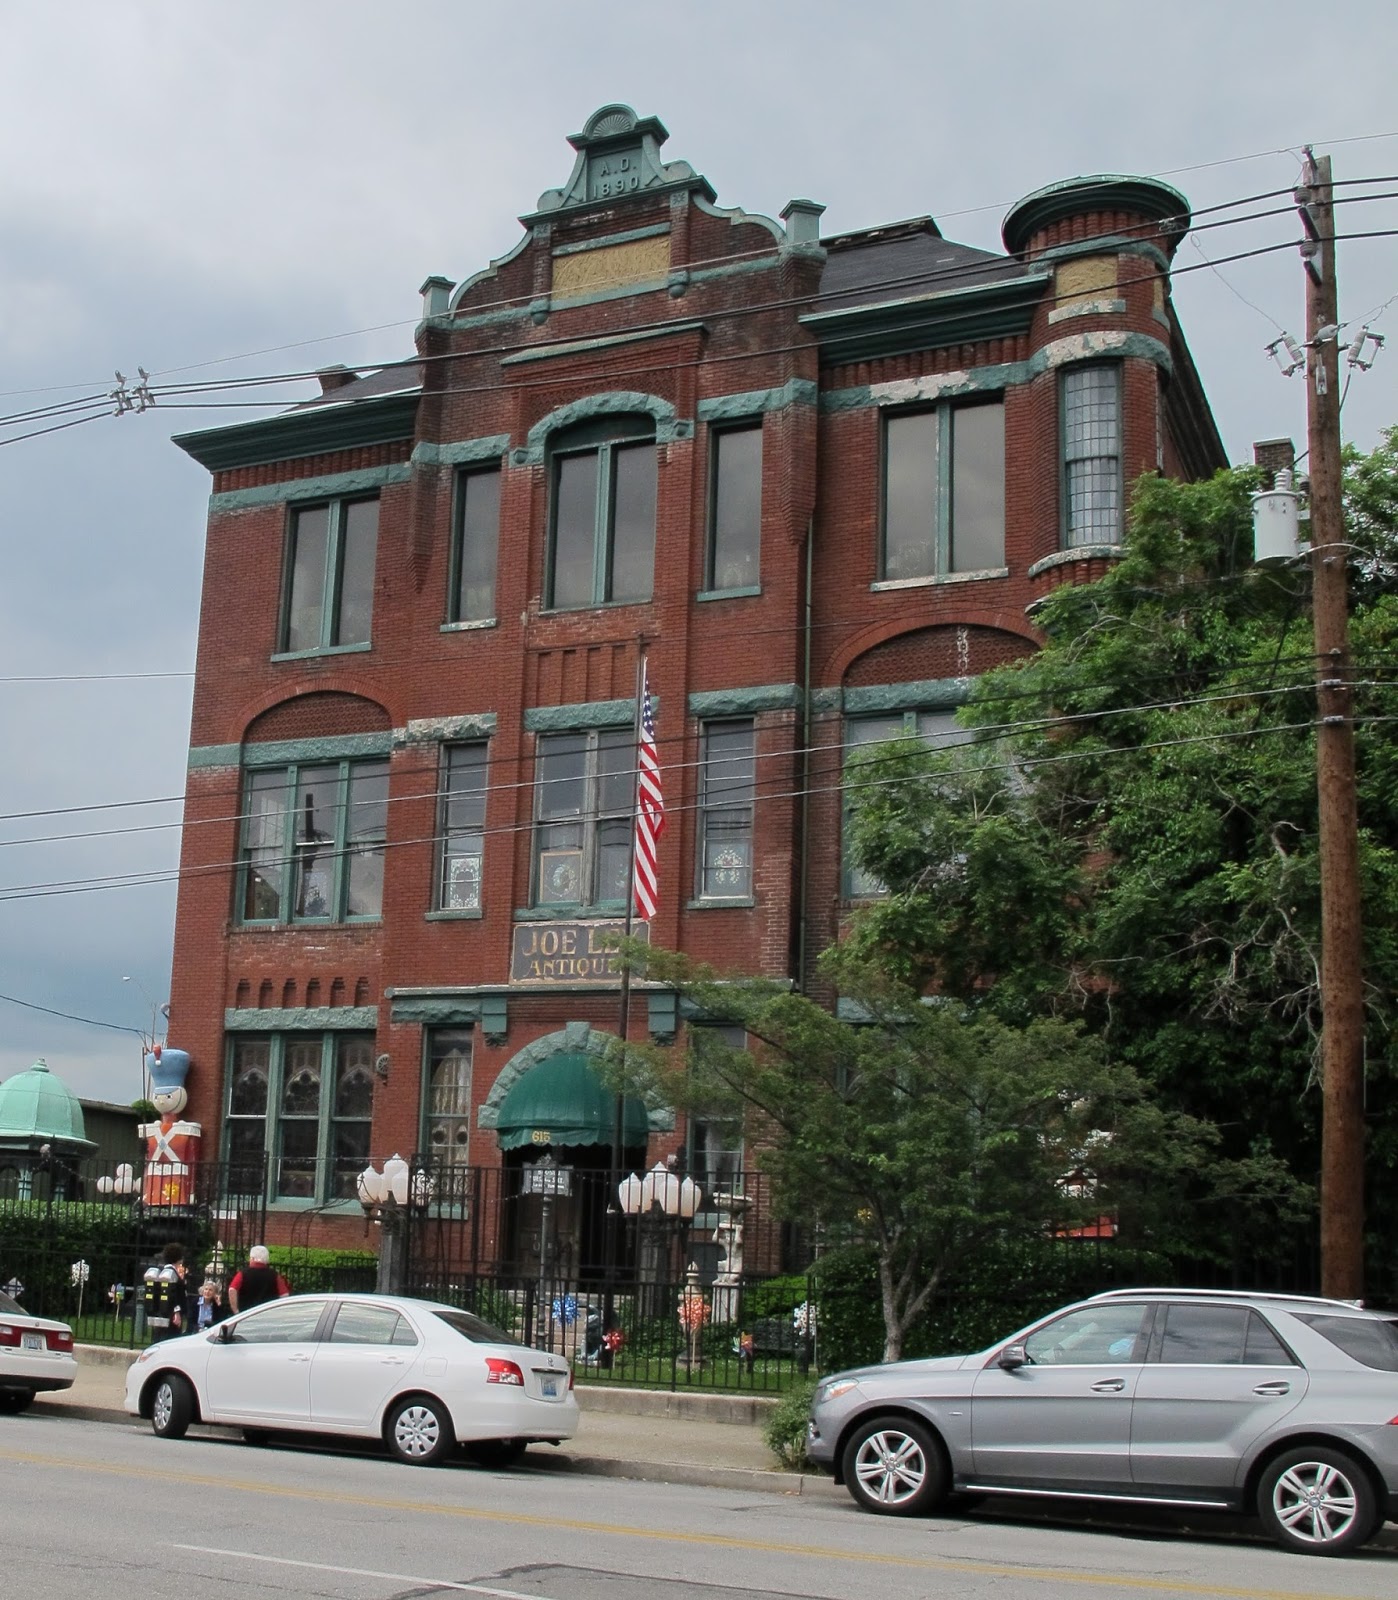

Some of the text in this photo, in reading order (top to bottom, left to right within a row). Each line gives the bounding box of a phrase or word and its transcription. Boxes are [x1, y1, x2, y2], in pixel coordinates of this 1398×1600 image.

[600, 157, 637, 177] A.D.
[593, 176, 639, 198] 1890
[521, 930, 577, 956] JOE
[531, 1130, 551, 1143] 615
